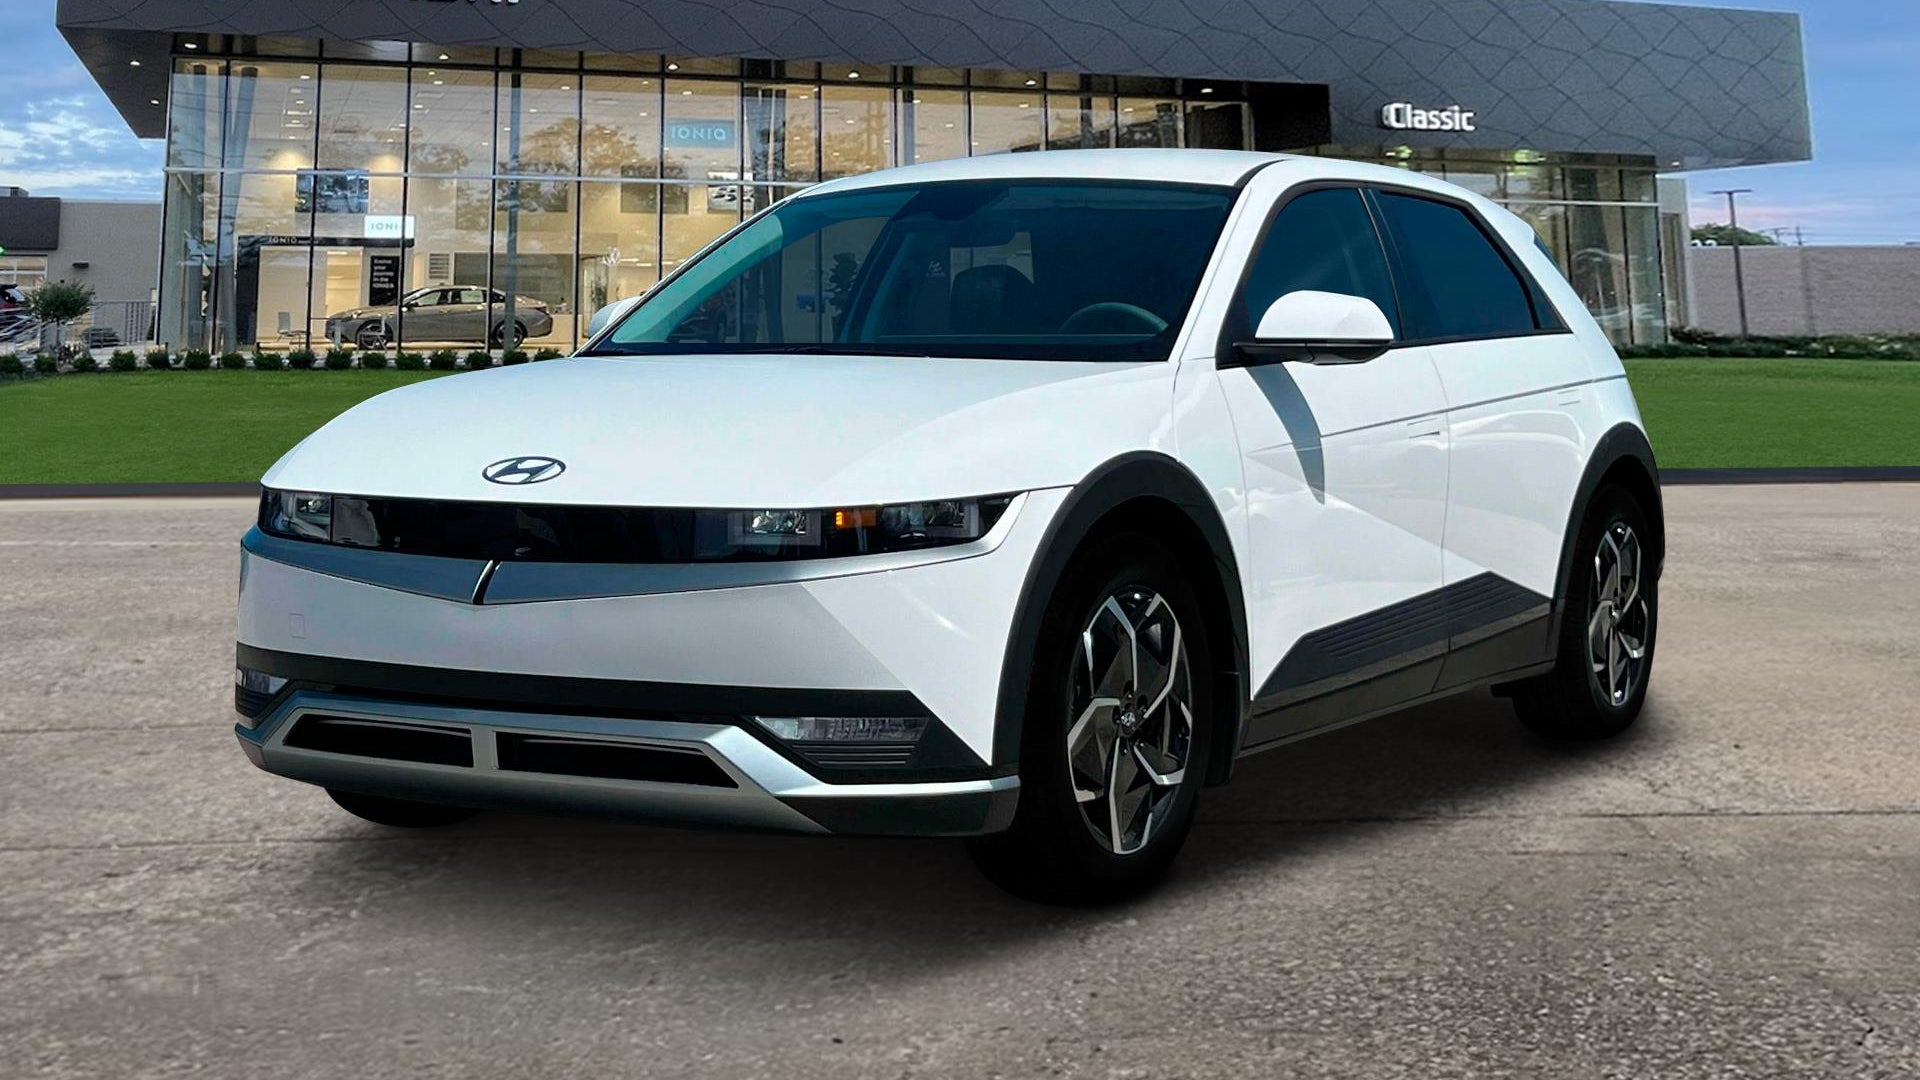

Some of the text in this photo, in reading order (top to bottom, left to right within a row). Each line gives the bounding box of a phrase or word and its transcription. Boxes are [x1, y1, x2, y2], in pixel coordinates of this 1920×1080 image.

[1382, 103, 1475, 131] Classic
[671, 127, 726, 141] IONIQ
[370, 222, 402, 231] IONI
